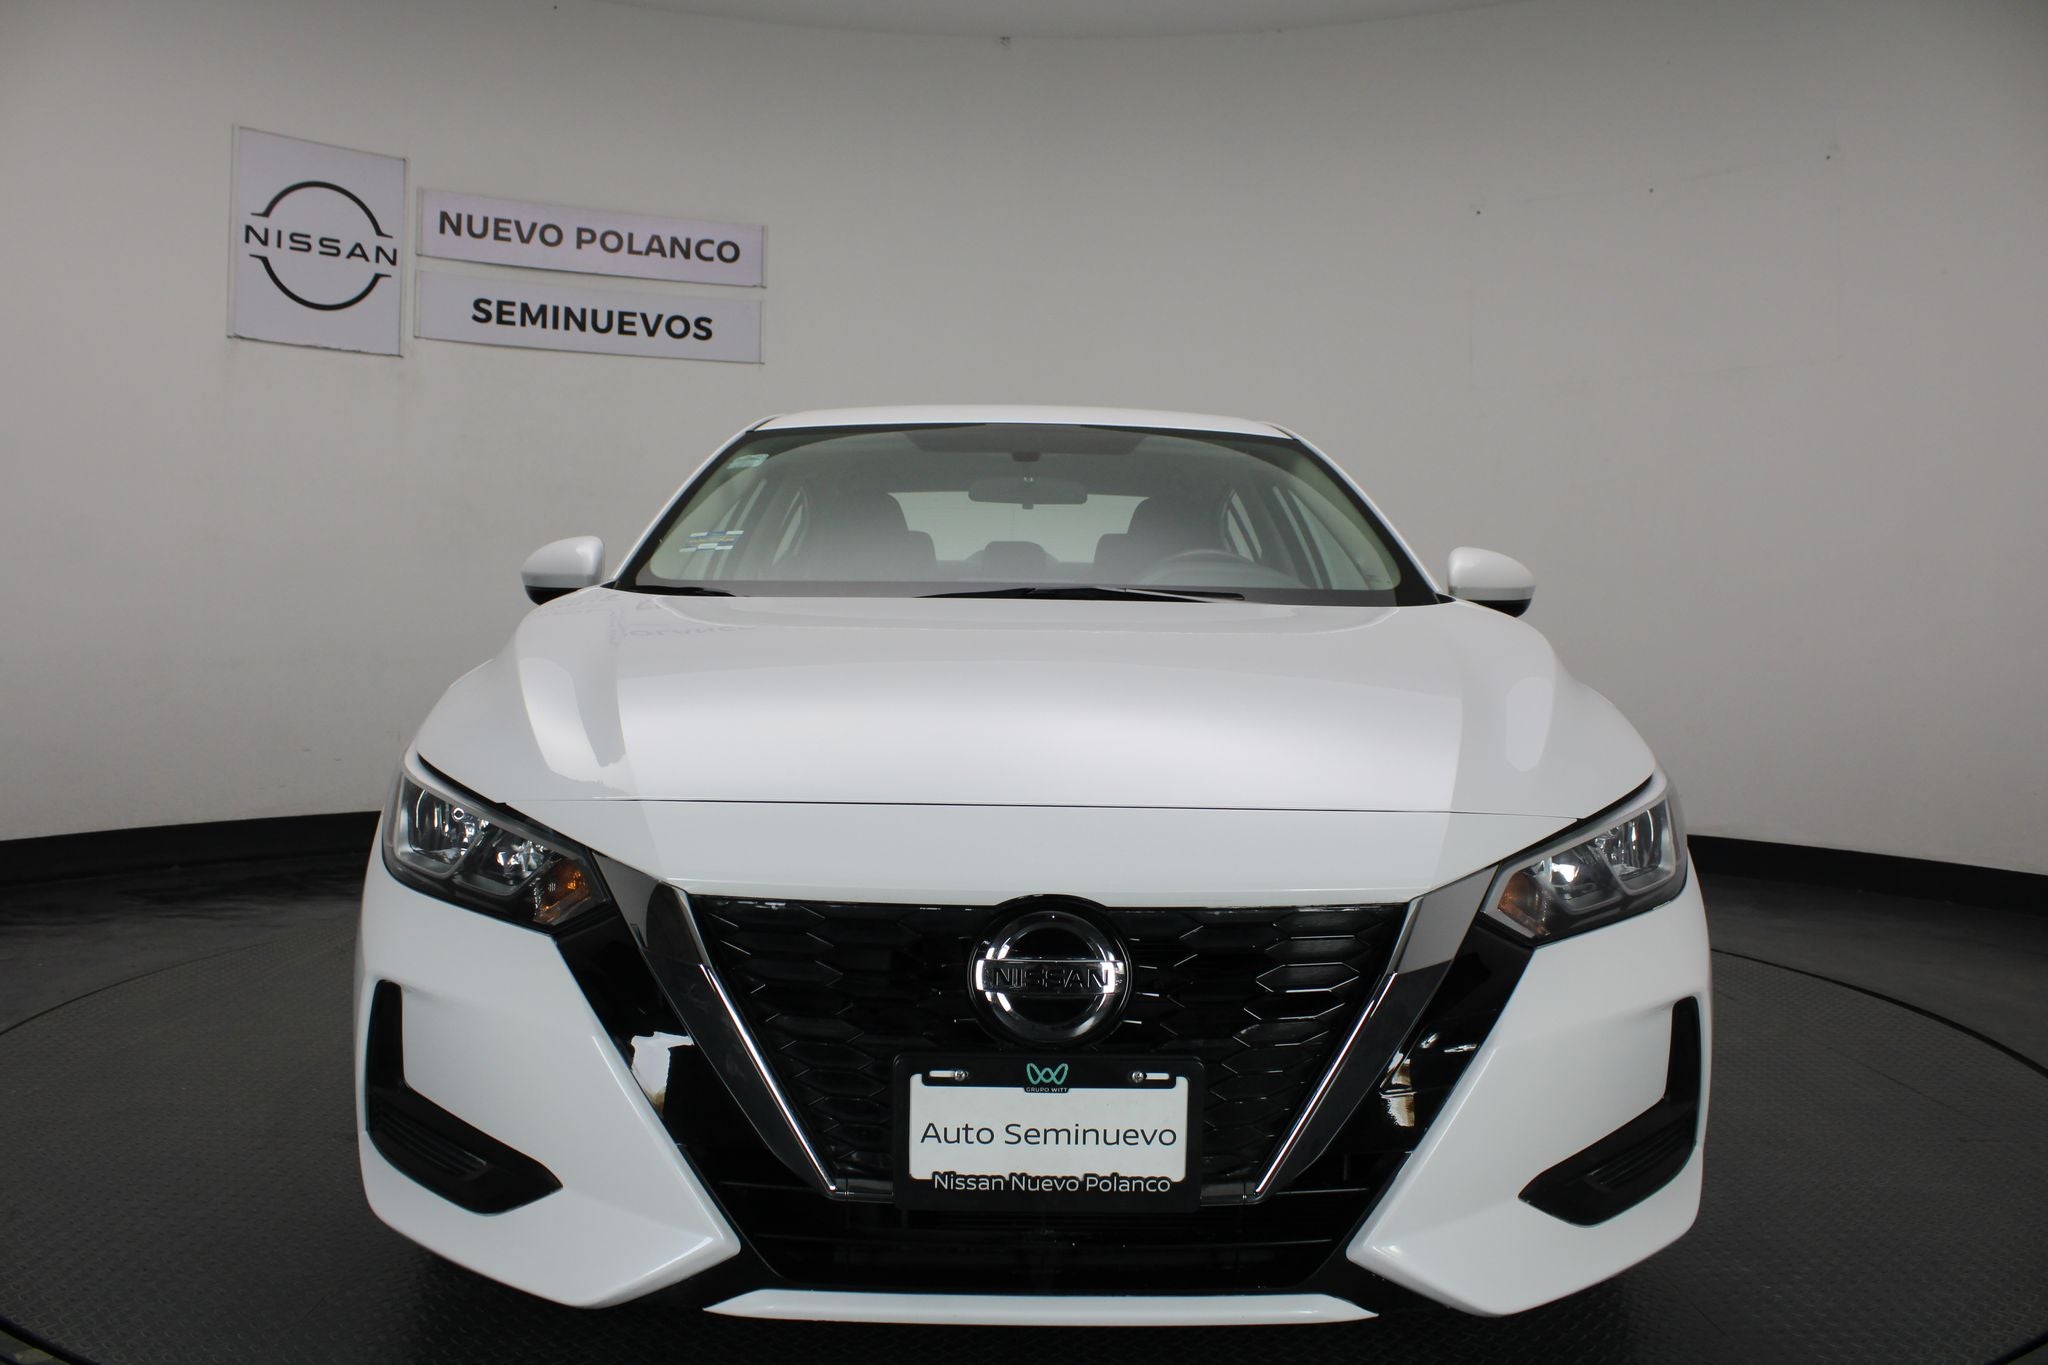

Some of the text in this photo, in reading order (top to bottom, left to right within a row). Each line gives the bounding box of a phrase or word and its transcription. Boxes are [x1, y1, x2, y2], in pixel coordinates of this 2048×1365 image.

[244, 223, 398, 267] NISSAN
[438, 209, 742, 264] NUEVO POLANCO
[471, 297, 714, 341] SEMINUEVOS
[993, 967, 1110, 989] NISSAN
[920, 1122, 1178, 1146] Auto Seminuevo
[934, 1173, 1171, 1193] Nissan Nuevo Polanco
